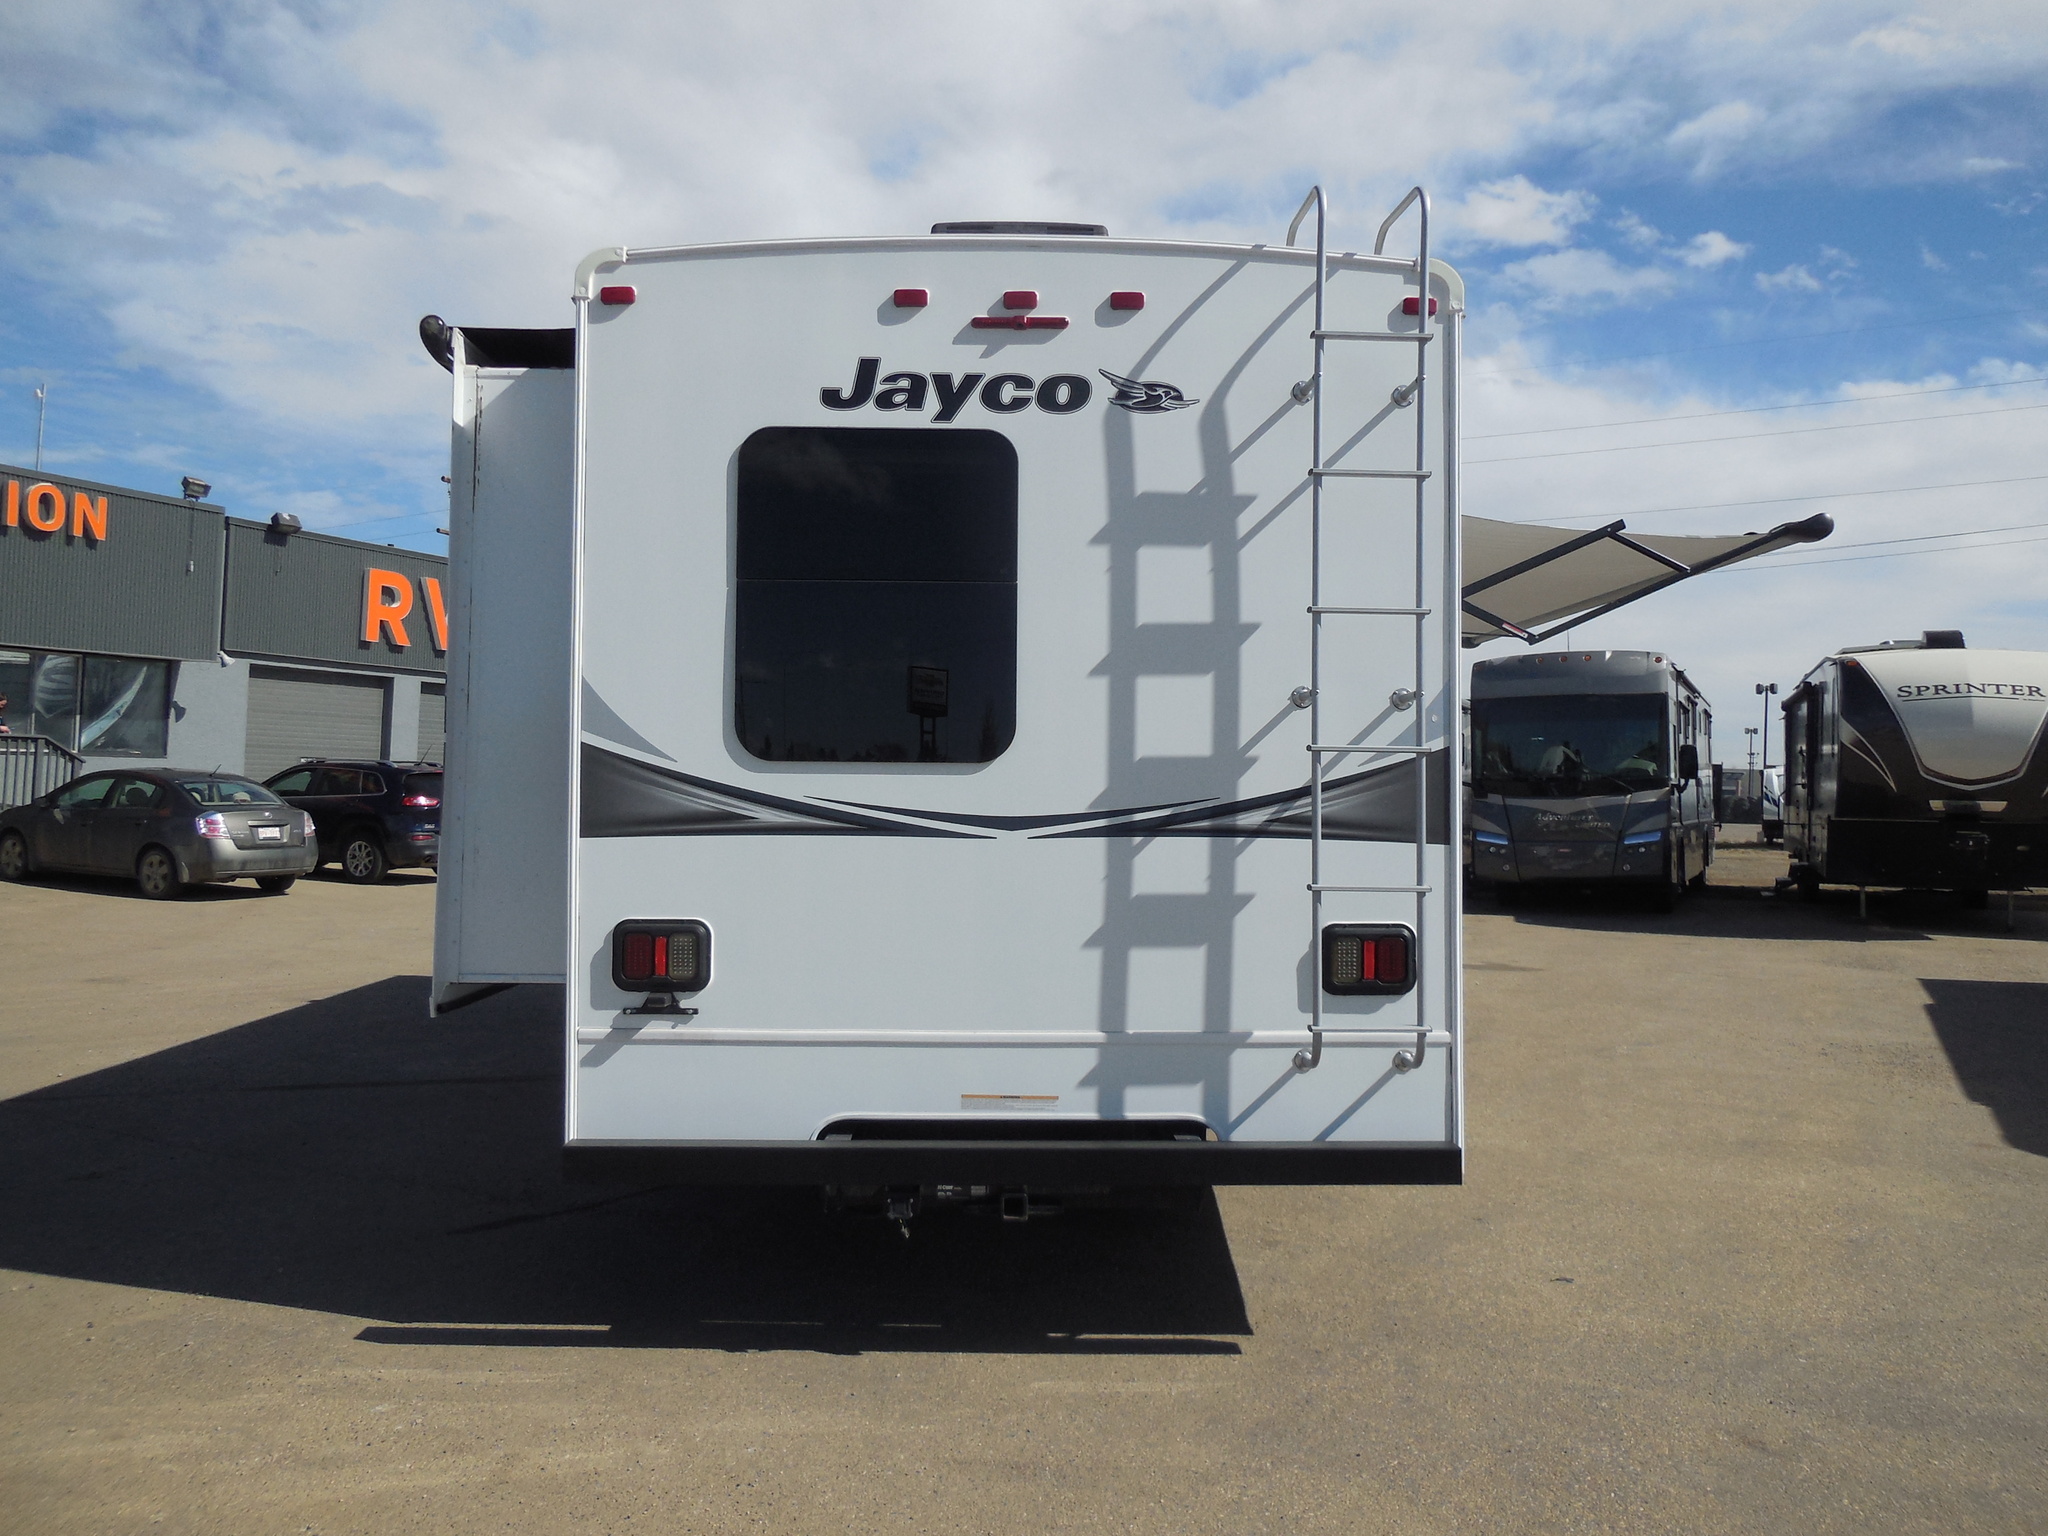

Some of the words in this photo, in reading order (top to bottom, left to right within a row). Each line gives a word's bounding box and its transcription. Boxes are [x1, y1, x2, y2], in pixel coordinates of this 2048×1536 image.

[819, 356, 1092, 423] Jayco
[6, 480, 108, 541] ION
[1897, 682, 2047, 698] SPRINTER
